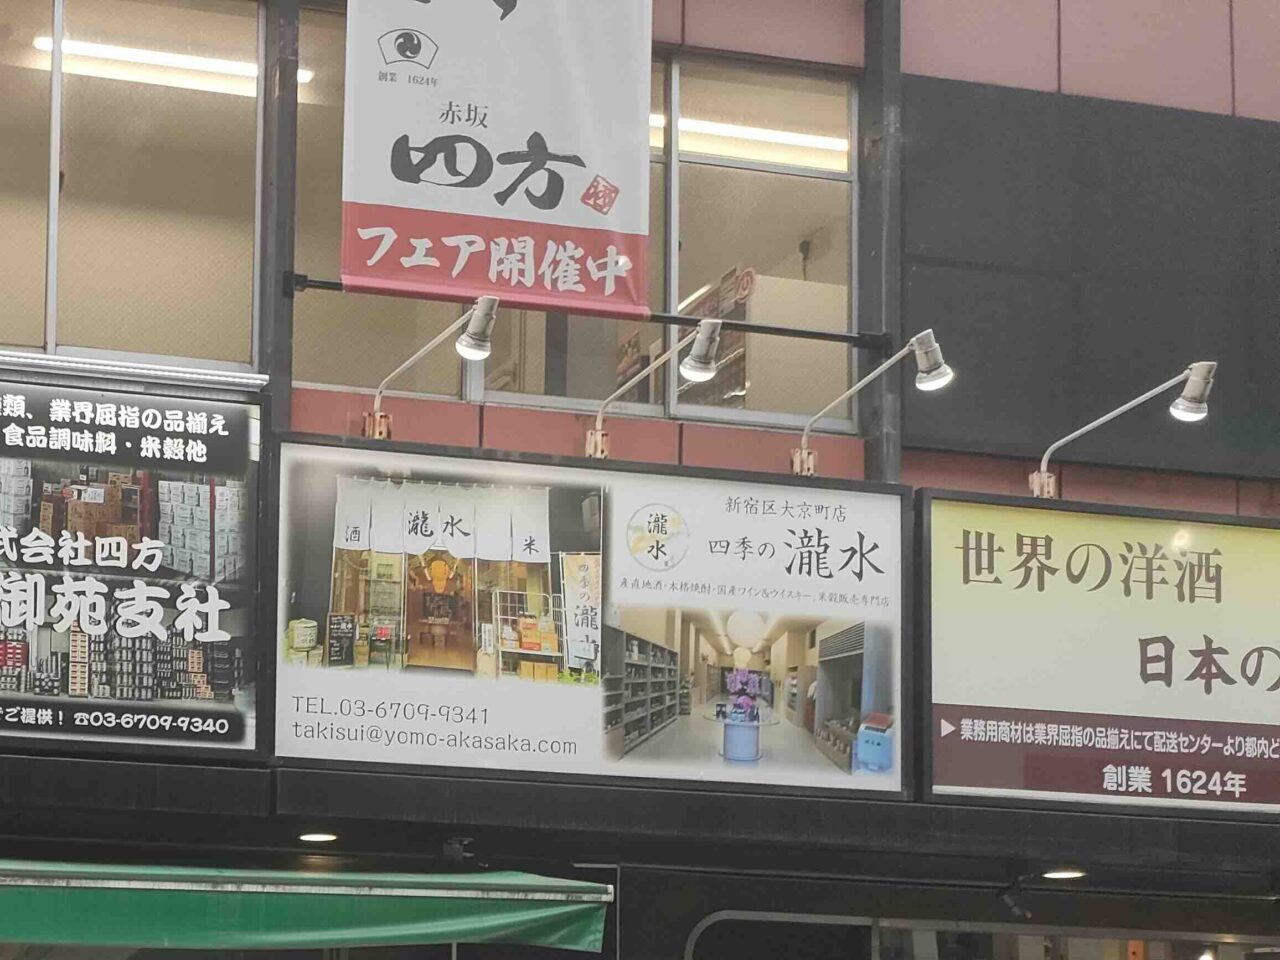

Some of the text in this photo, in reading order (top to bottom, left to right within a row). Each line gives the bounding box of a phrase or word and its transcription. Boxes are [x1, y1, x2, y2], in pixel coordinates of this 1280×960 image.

[439, 101, 489, 129] 赤坂
[390, 131, 587, 210] 四方
[357, 226, 633, 297] フェア開催中
[724, 496, 848, 523] 新宿区大京町店
[344, 510, 540, 556] 酒 瀧水 米
[647, 513, 669, 562] 瀧水
[954, 527, 1224, 604] 世界の洋酒
[1138, 633, 1280, 696] 日本の
[291, 695, 489, 725] TEL.03-6709-9341
[291, 721, 578, 755] takisui@yomo-akasaka.com
[1102, 763, 1248, 798] 創業 1624年
